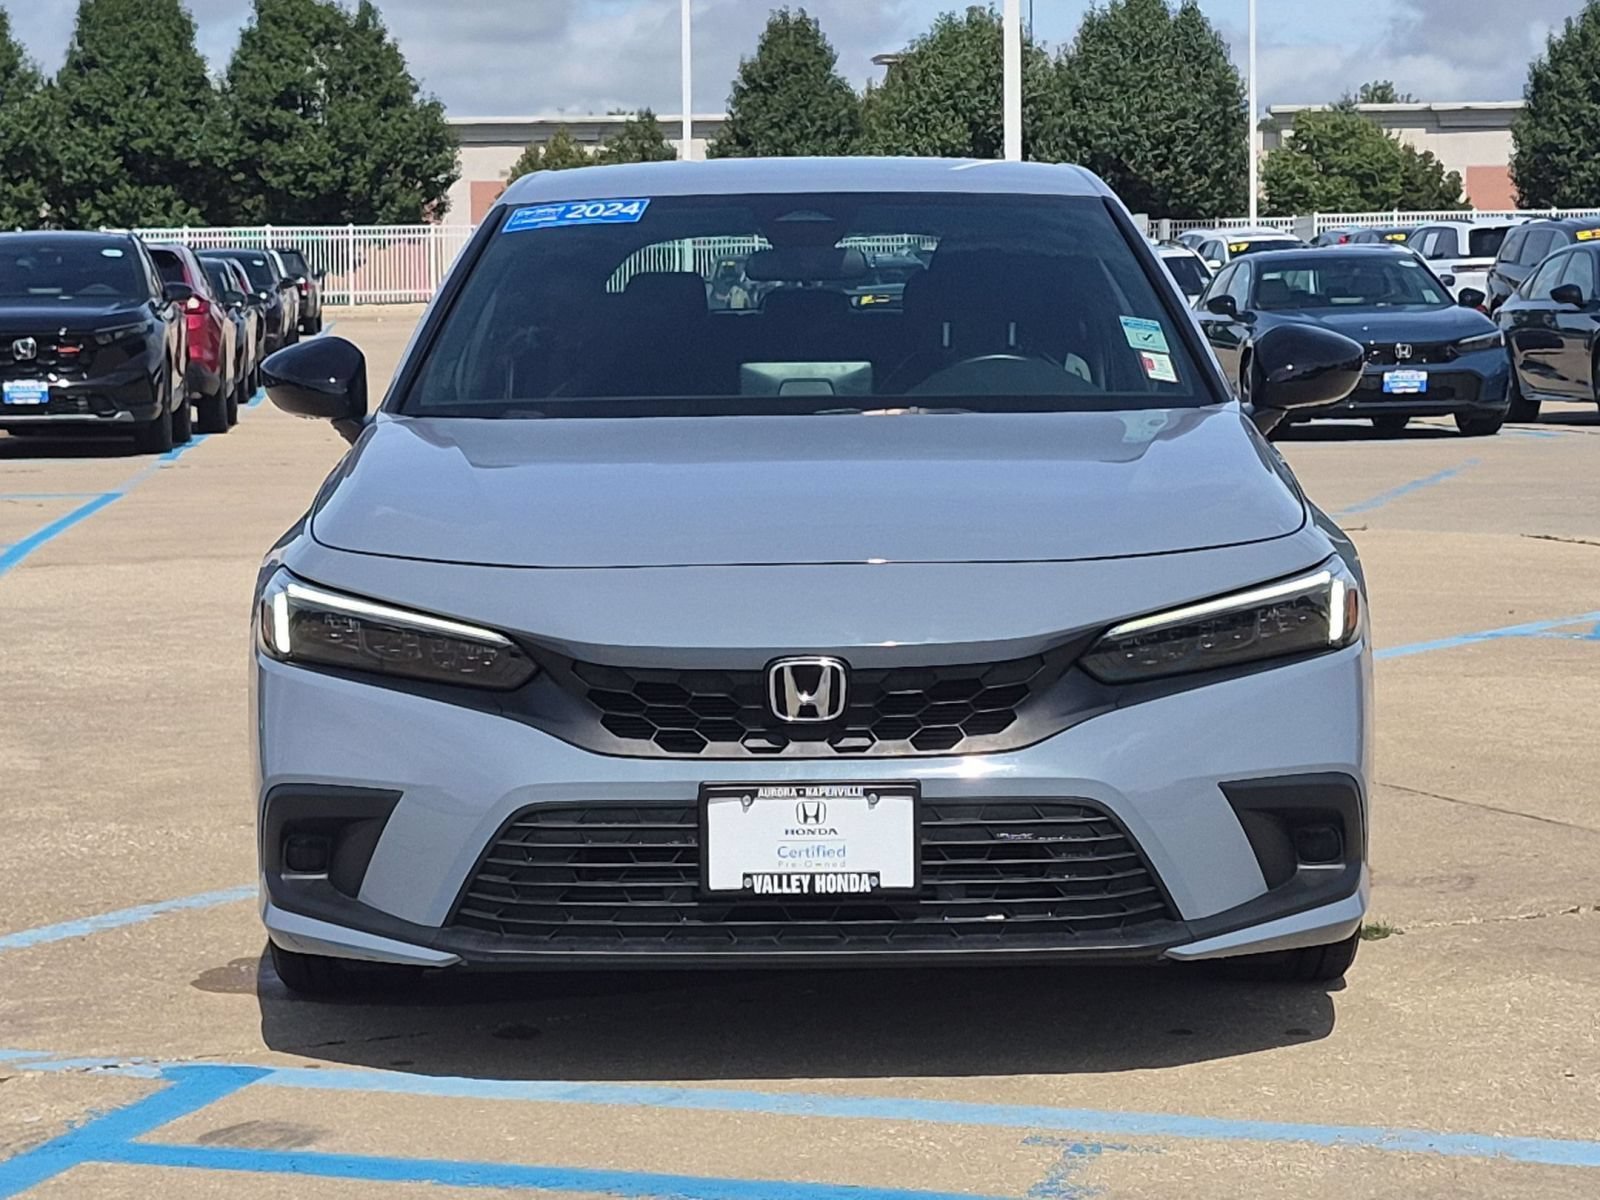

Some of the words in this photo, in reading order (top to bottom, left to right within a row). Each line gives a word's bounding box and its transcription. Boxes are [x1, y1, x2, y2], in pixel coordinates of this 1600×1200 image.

[566, 201, 640, 219] 2024
[758, 786, 798, 798] AURORA
[805, 785, 864, 797] NAPERVILLE
[785, 828, 839, 836] HONDA
[777, 844, 846, 859] Certified
[752, 874, 811, 894] VALLEY
[814, 873, 871, 893] HONDA
